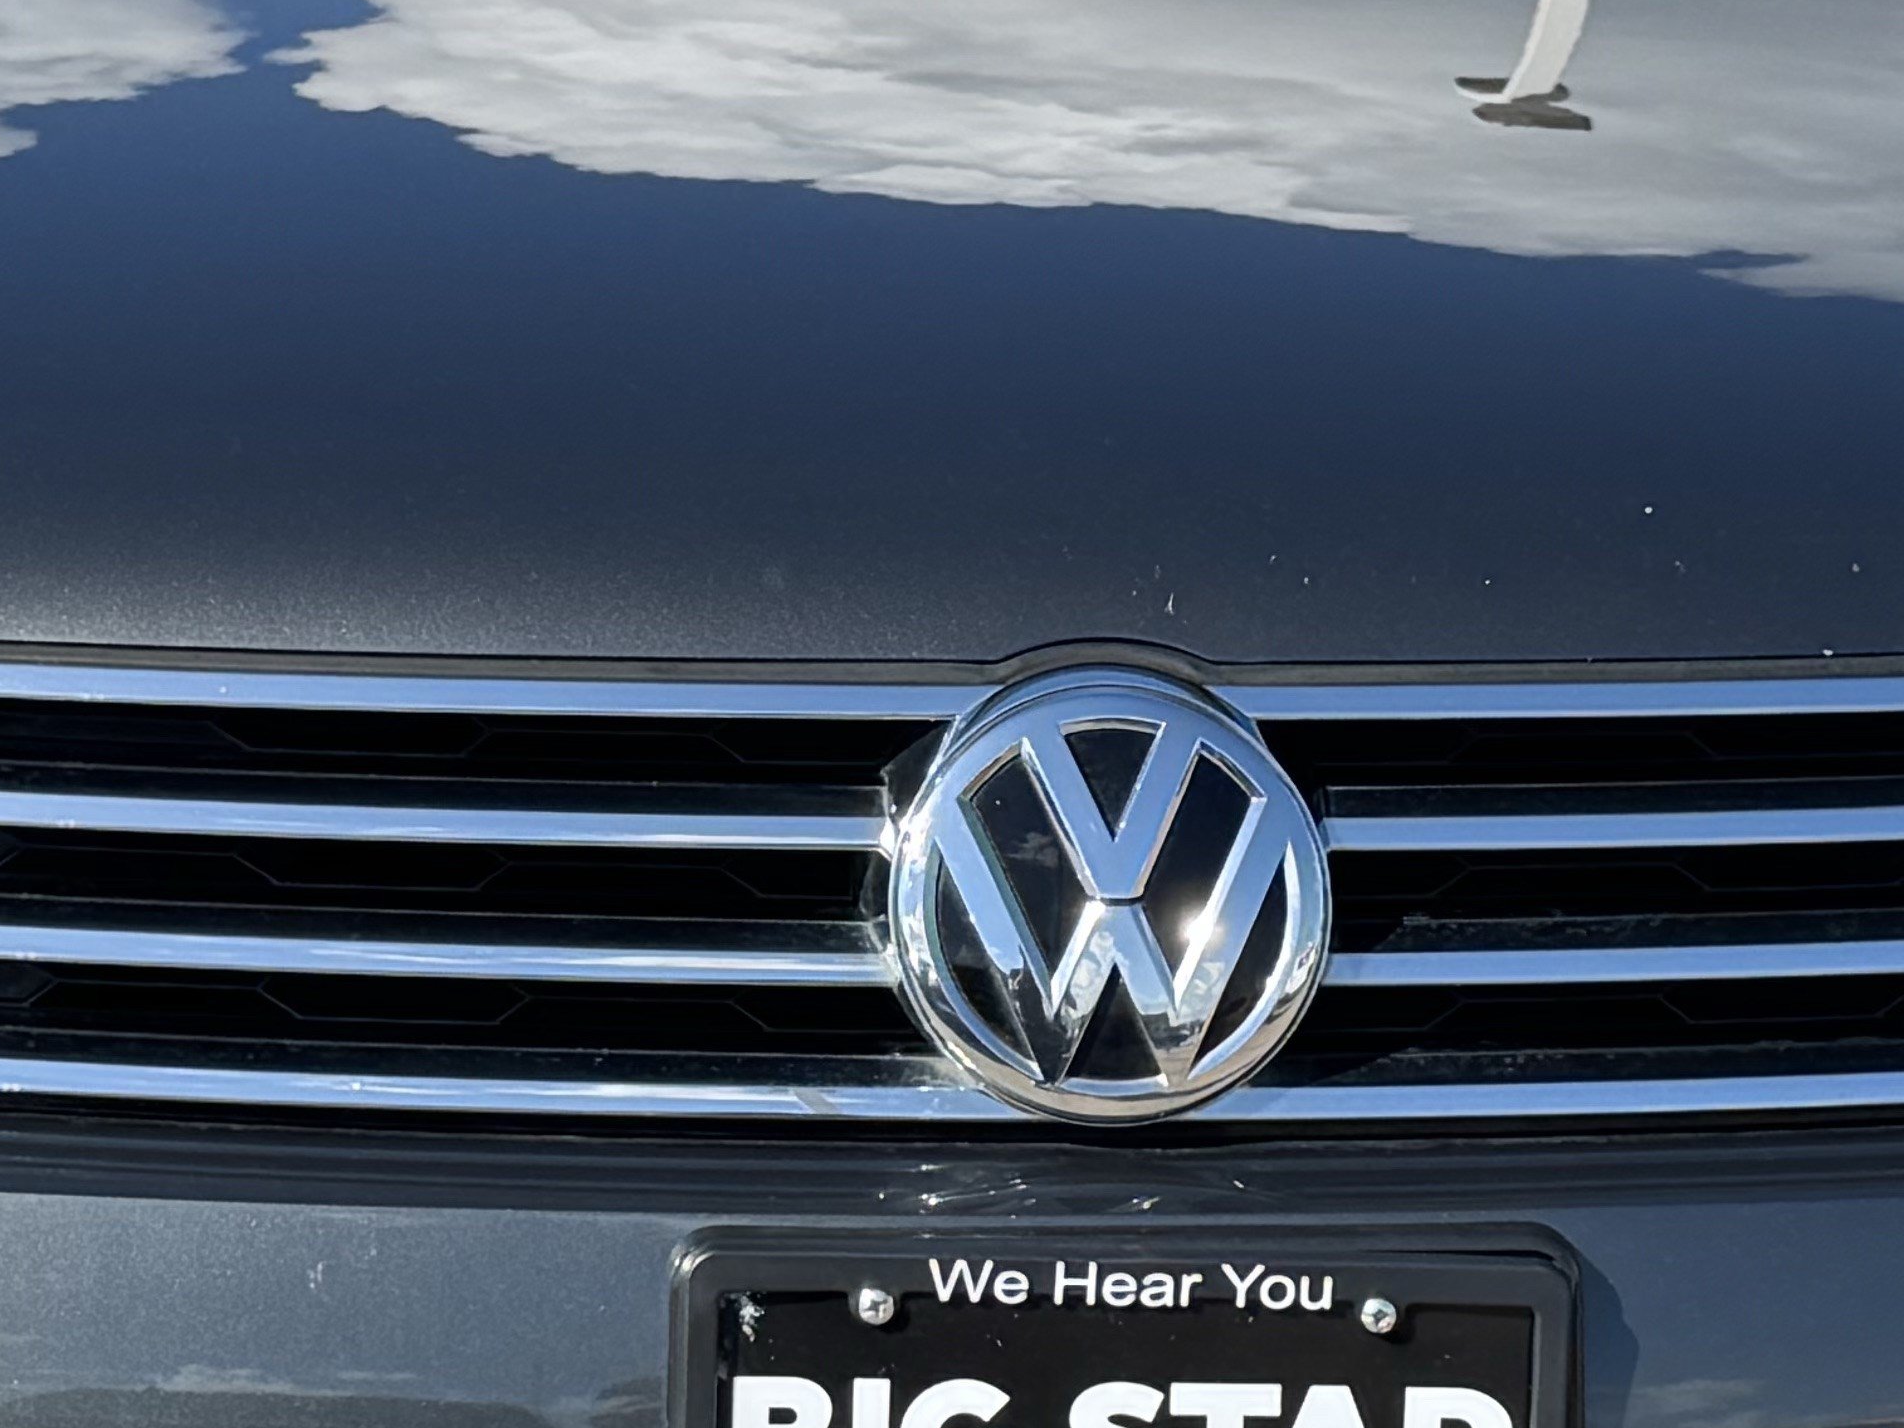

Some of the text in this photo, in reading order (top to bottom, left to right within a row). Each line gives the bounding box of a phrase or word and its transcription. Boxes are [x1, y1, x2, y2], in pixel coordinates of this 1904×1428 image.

[928, 1258, 1334, 1311] We Hear You
